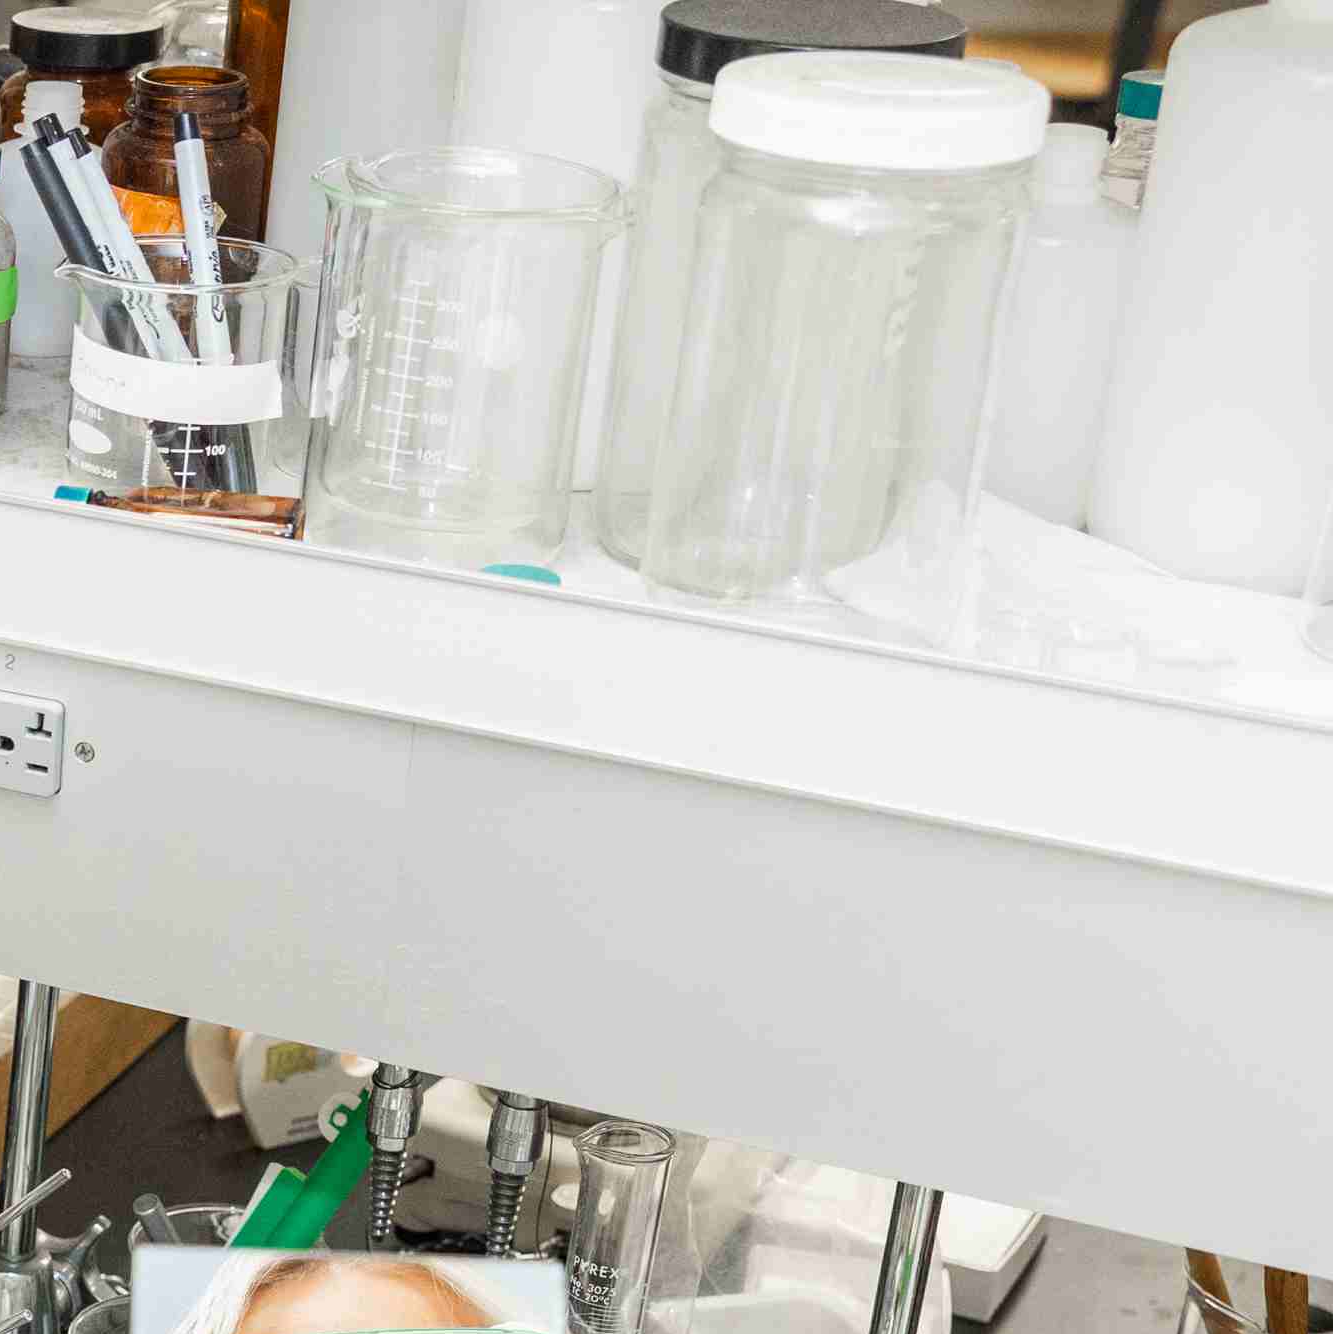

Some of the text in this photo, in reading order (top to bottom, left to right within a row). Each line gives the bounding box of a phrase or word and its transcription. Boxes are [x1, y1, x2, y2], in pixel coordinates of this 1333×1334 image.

[204, 444, 227, 457] 100
[4, 652, 16, 671] 2
[573, 1255, 620, 1280] PYREX
